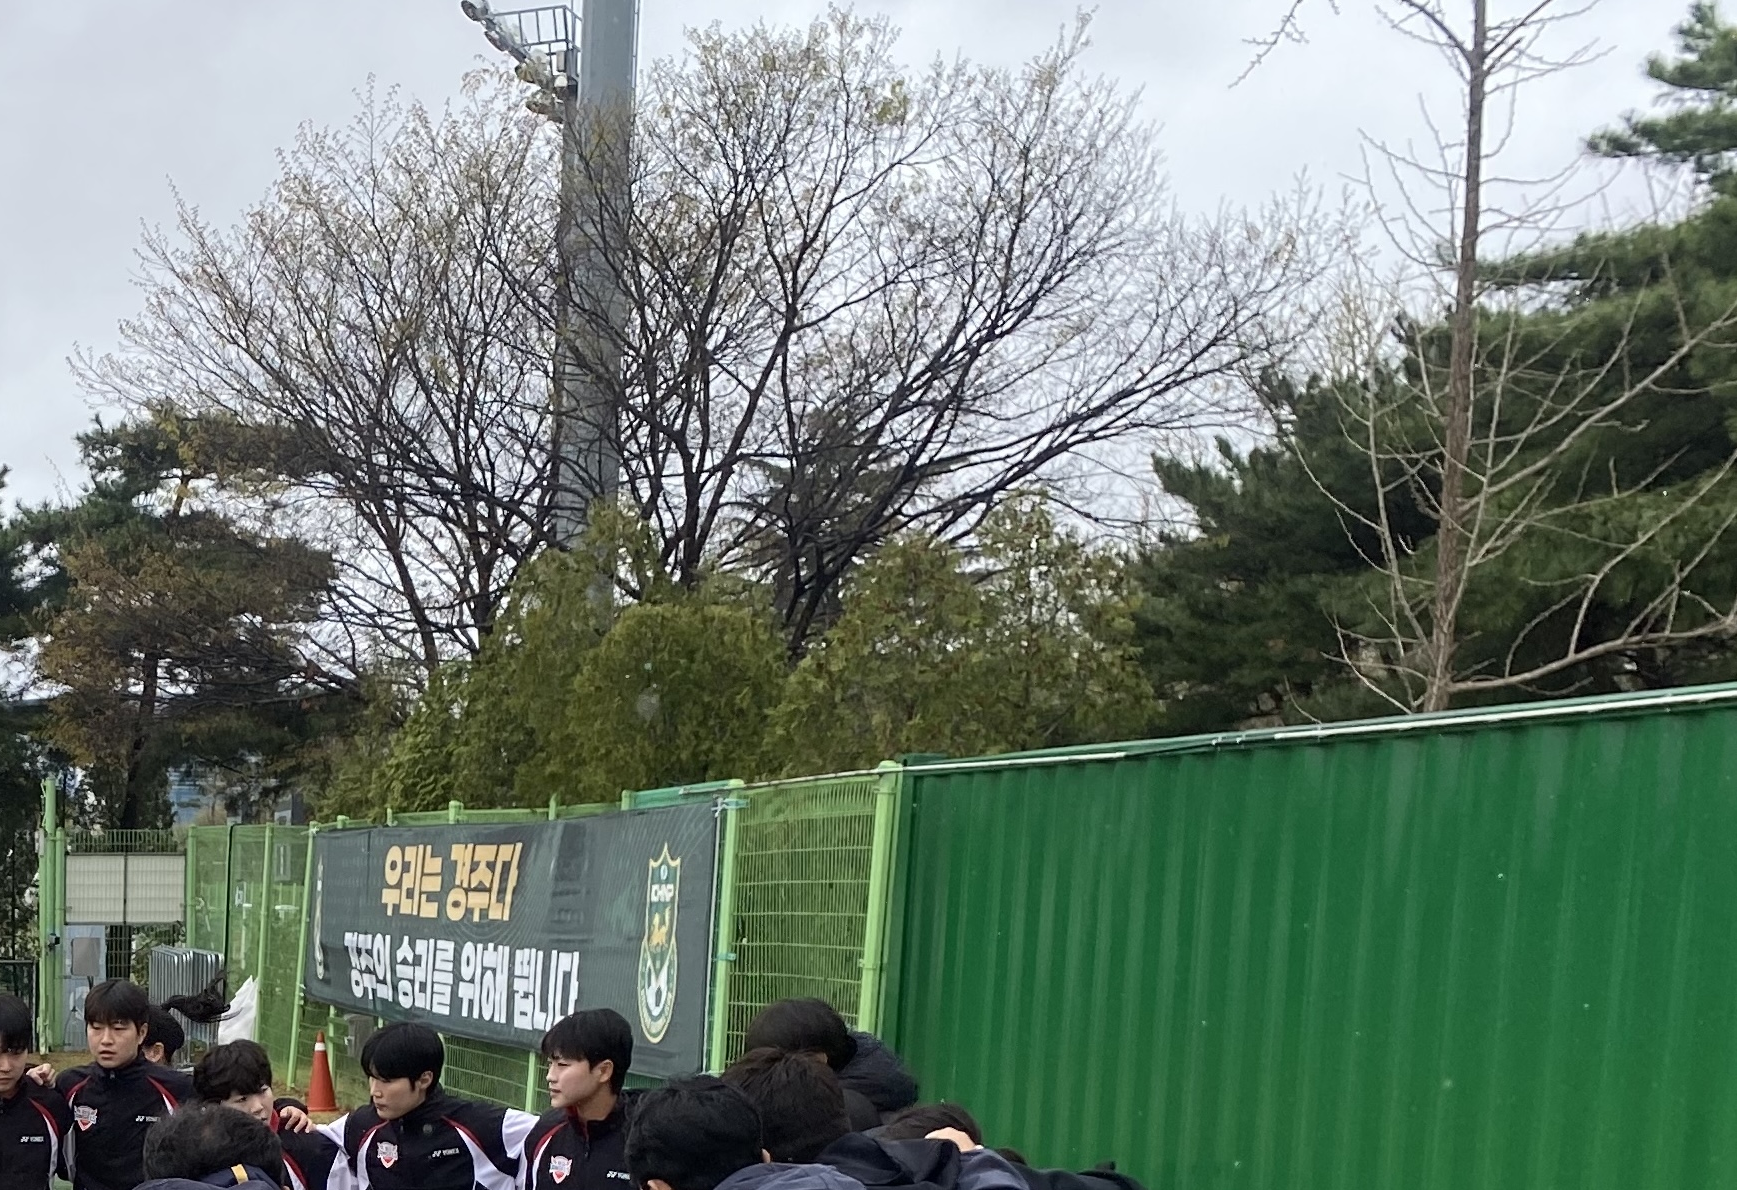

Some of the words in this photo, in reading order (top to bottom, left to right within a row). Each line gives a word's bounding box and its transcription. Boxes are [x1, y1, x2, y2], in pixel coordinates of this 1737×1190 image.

[381, 844, 444, 919] 우리는
[446, 842, 523, 922] 경주다
[344, 931, 394, 1002] 경주의
[395, 935, 455, 1016] 승리를
[457, 940, 511, 1025] 위해
[513, 947, 580, 1032] 뜁니다
